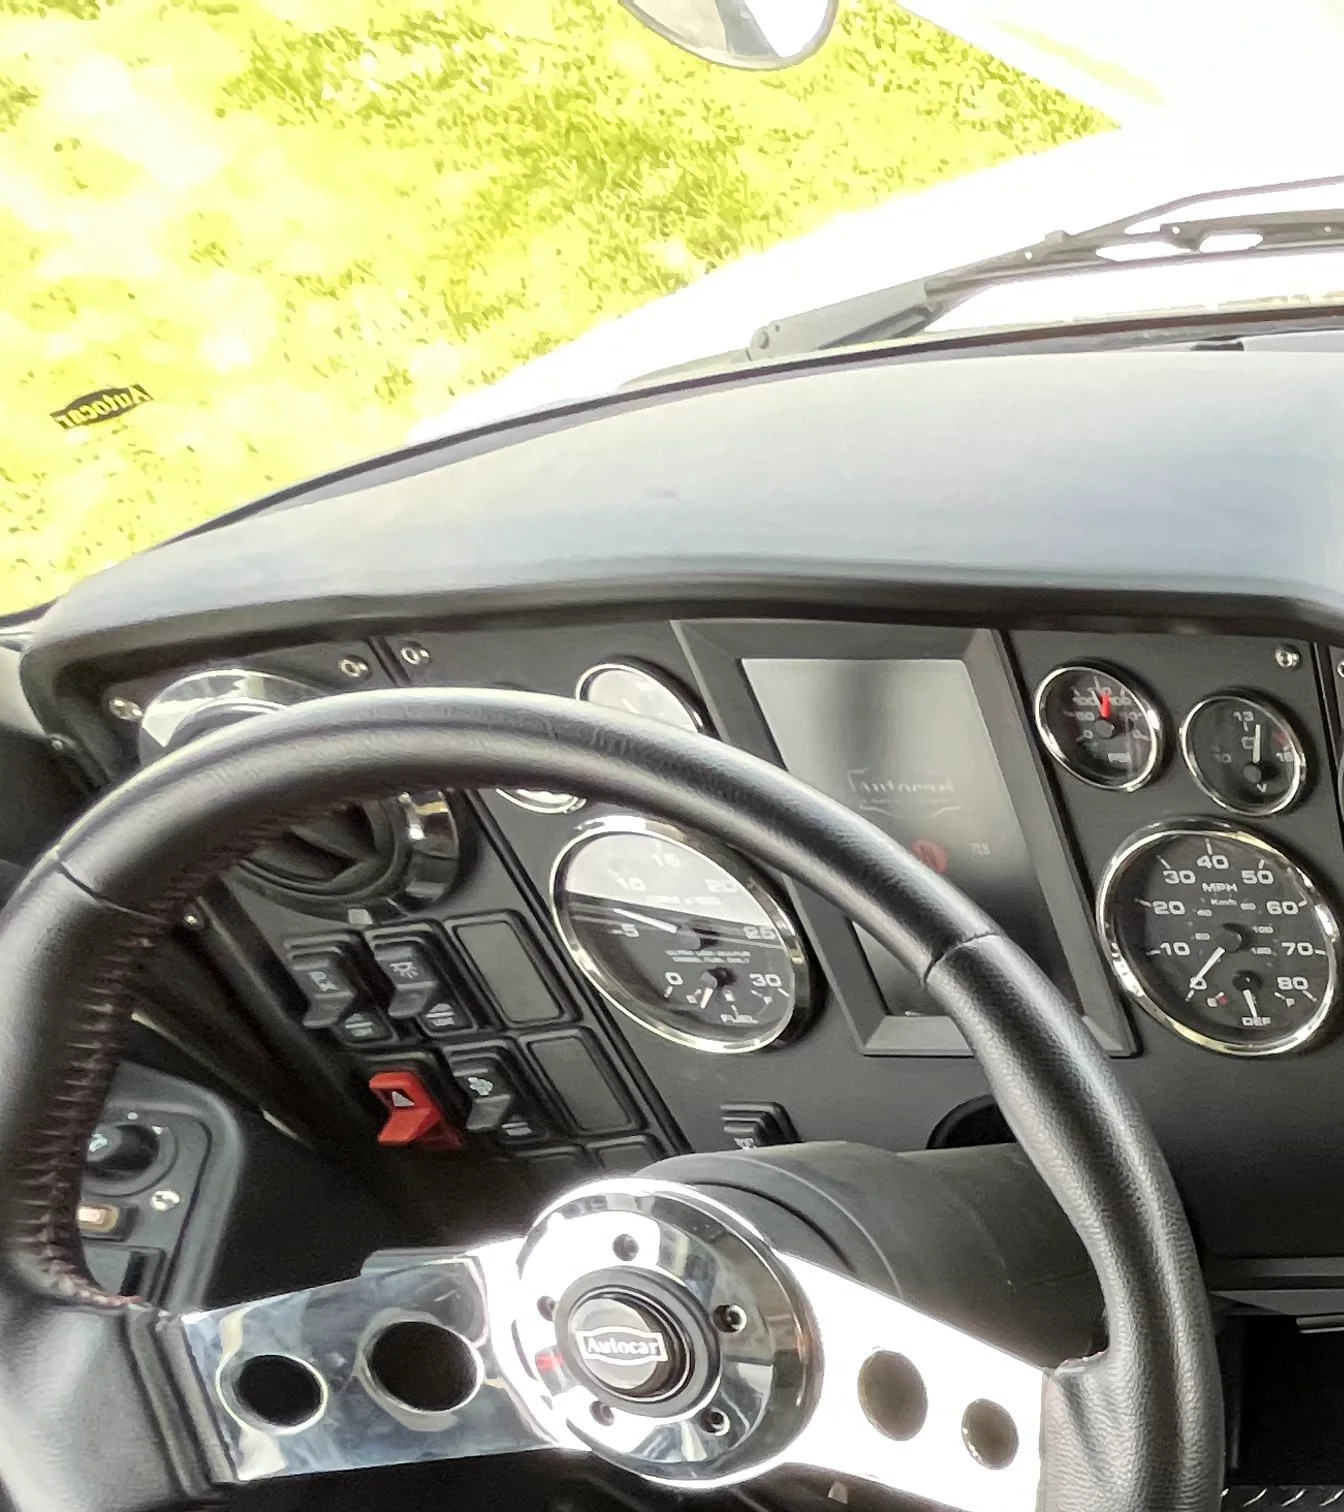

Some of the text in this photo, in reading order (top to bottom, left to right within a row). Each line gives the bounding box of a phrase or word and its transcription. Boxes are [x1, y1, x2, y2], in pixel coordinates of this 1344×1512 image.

[1256, 783, 1268, 793] V
[1195, 854, 1230, 870] 40
[615, 877, 647, 892] 10
[1162, 869, 1196, 885] 30
[1240, 869, 1274, 885] 50
[1201, 882, 1239, 894] MPH
[1151, 900, 1186, 915] 20
[1265, 900, 1300, 915] 60
[620, 923, 640, 938] 5
[1159, 941, 1191, 956] 10
[1280, 941, 1314, 956] 70
[664, 971, 684, 986] 0
[748, 972, 783, 987] 30
[1276, 976, 1309, 990] 80
[584, 1336, 660, 1358] Autocar
